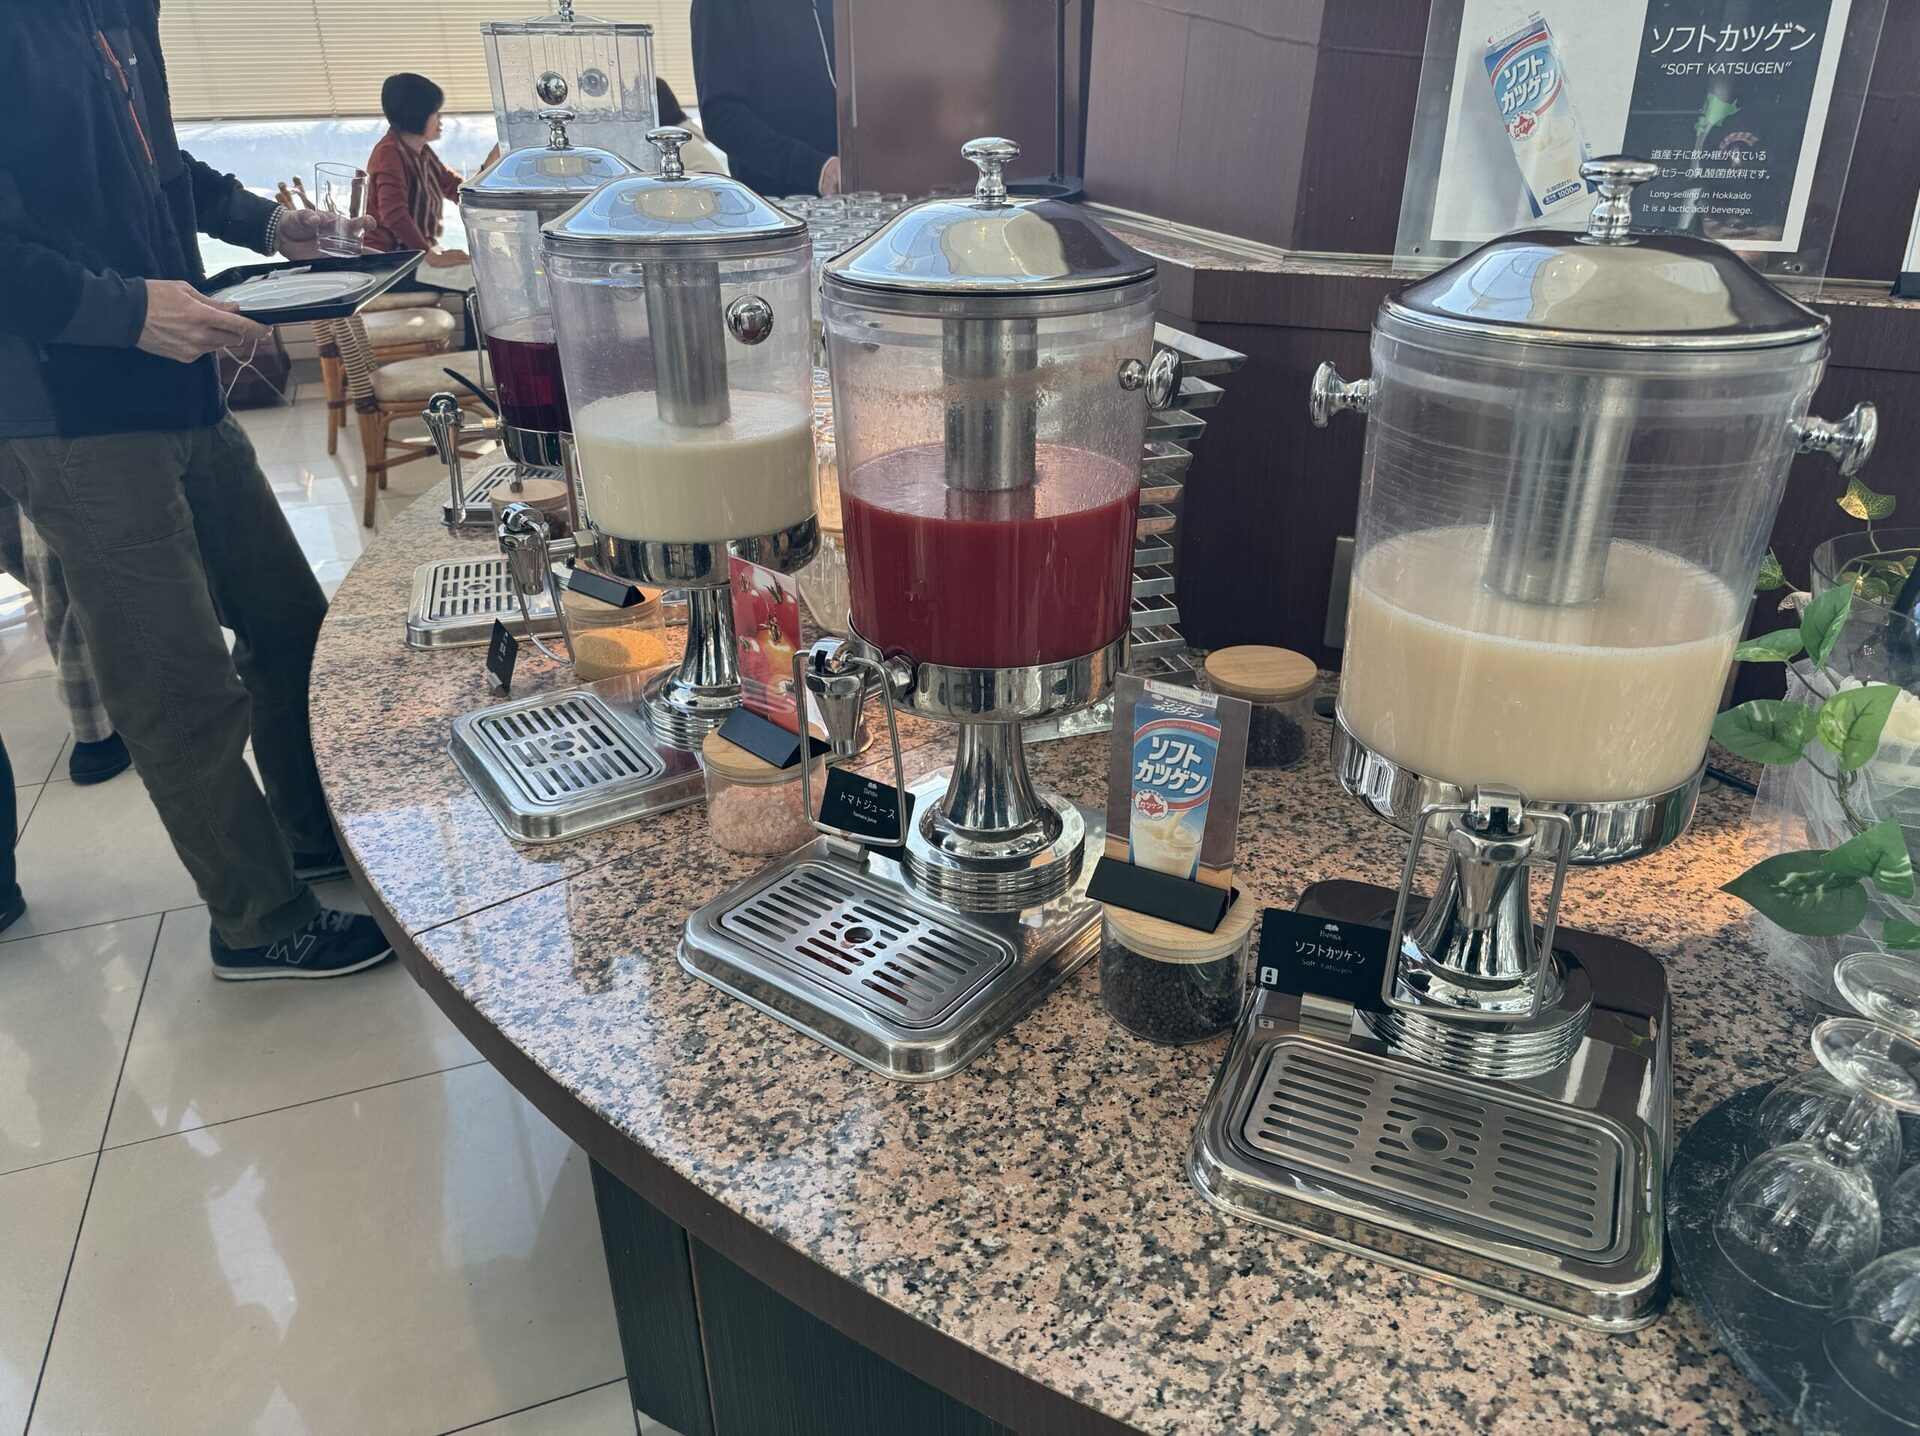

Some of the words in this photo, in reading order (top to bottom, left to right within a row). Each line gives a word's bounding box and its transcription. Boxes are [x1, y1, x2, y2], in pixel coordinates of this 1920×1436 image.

[1650, 22, 1817, 53] ソフトカツゲン
[1503, 54, 1546, 90] ソフト
[1501, 69, 1556, 115] カツゲン
[1650, 149, 1767, 161] 道産子に飲み継がれている
[1642, 203, 1649, 212] It
[1651, 203, 1658, 212] is
[1668, 204, 1690, 213] lactic
[1711, 206, 1753, 215] beverage.
[1649, 190, 1700, 200] Long-selling
[1701, 190, 1710, 199] in
[1712, 191, 1752, 200] Hokkaido
[1148, 736, 1202, 769] ソフト
[1134, 759, 1208, 795] カツゲン
[840, 791, 895, 820] トマトジュース
[1295, 940, 1366, 964] ソフトカツゲン
